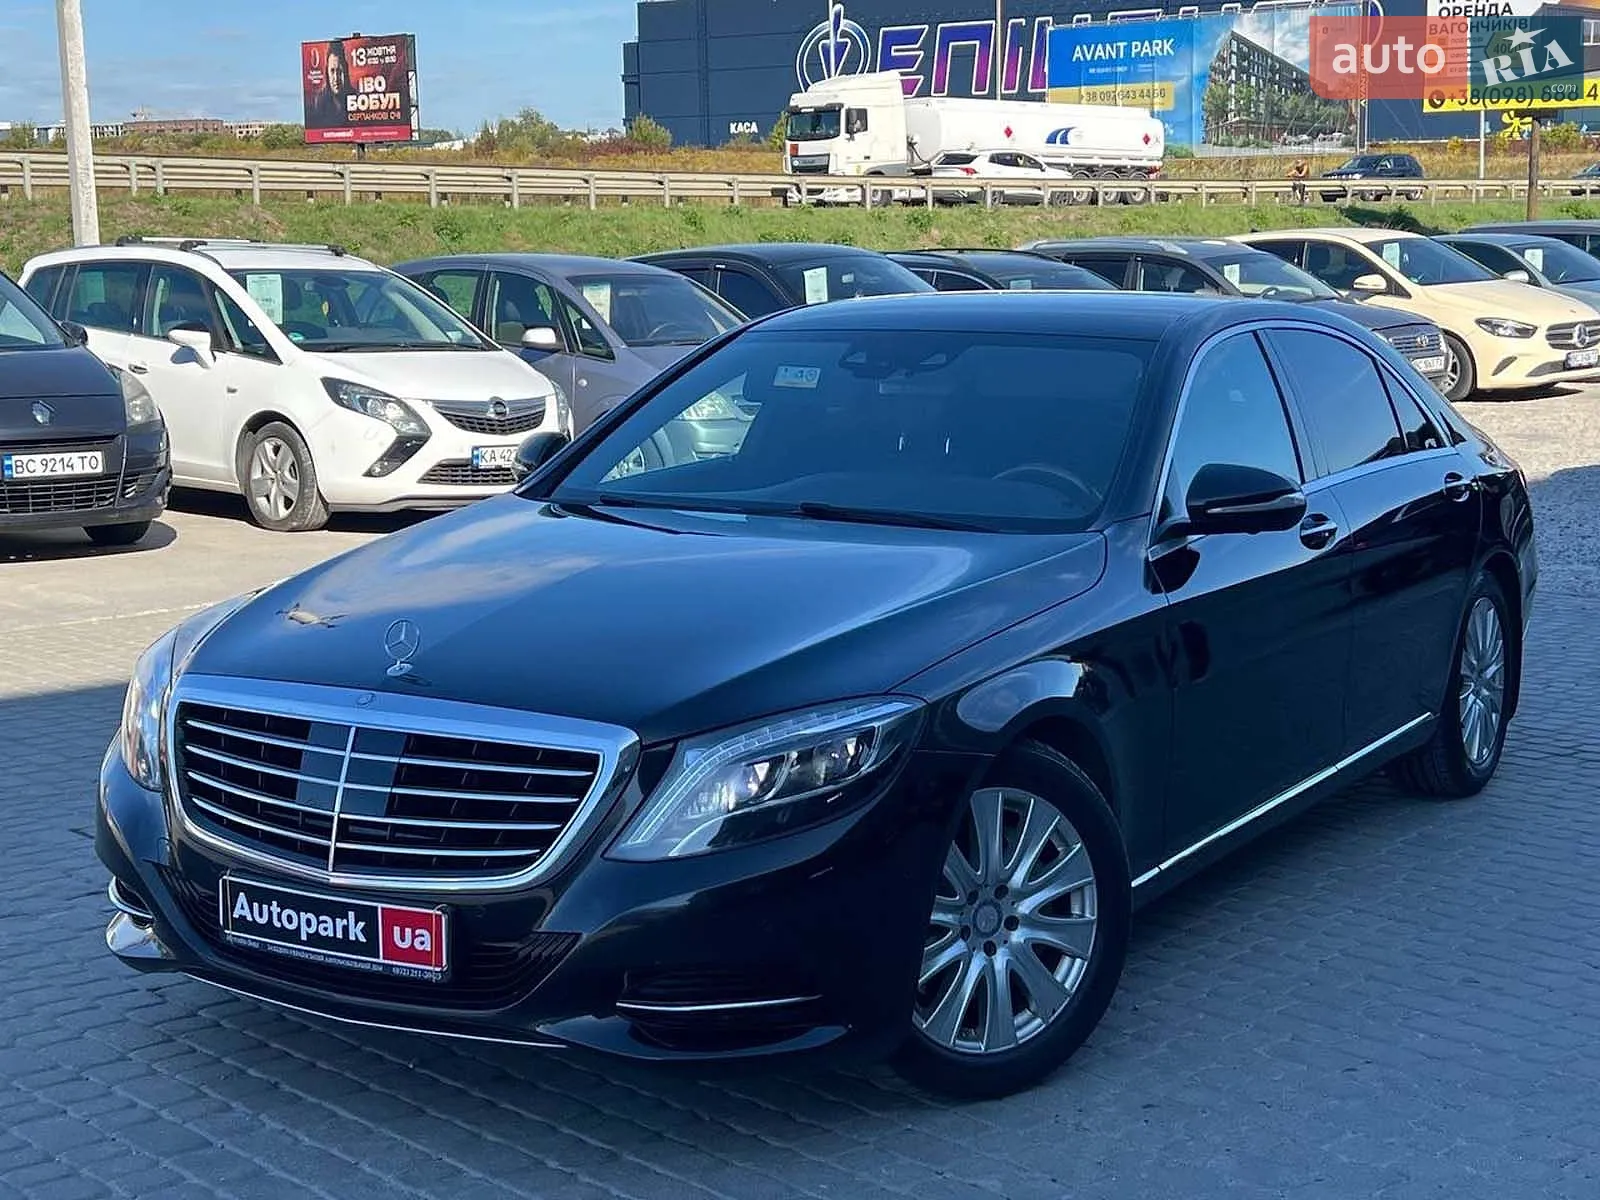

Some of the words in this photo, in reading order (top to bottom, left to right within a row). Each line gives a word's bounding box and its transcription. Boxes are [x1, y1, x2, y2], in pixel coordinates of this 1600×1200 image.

[1438, 3, 1513, 20] ОРЕНДА
[1429, 18, 1529, 36] ВАГОНЧИКІВ
[351, 48, 367, 67] 13
[1072, 42, 1128, 62] AVANT
[1131, 38, 1175, 58] PARK
[358, 75, 387, 93] ІВО
[346, 92, 401, 111] БОБУЛ
[729, 121, 759, 134] КАСА
[14, 459, 37, 474] BC
[40, 456, 75, 473] 9214
[232, 891, 367, 942] Autopark
[393, 925, 432, 951] ua
